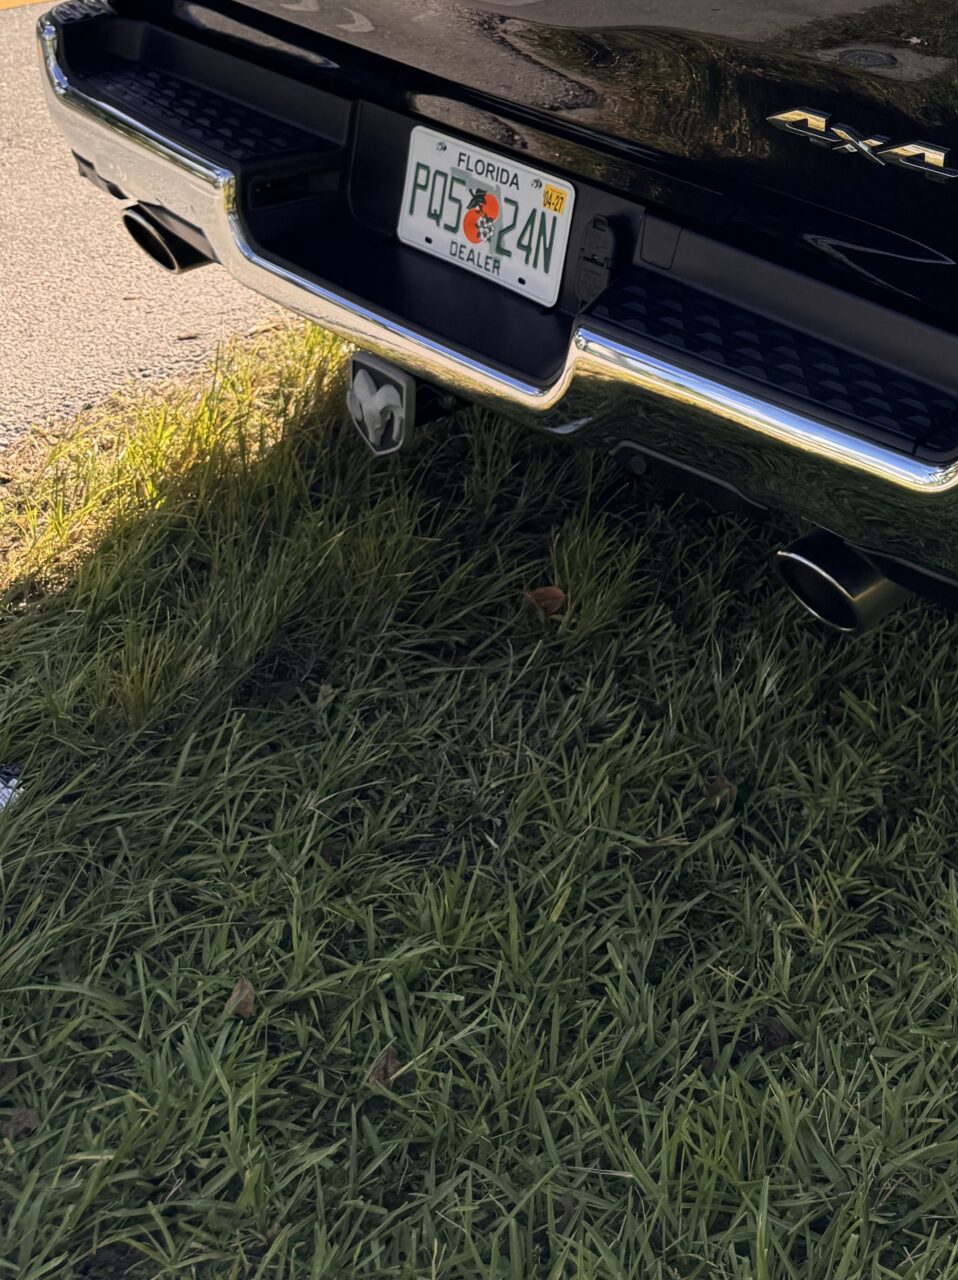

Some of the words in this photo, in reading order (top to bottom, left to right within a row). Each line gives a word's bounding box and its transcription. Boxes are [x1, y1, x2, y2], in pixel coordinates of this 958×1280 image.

[457, 152, 520, 190] FLORIDA
[408, 161, 466, 234] PQ5
[496, 197, 558, 274] 24N
[449, 240, 501, 276] DEALER
